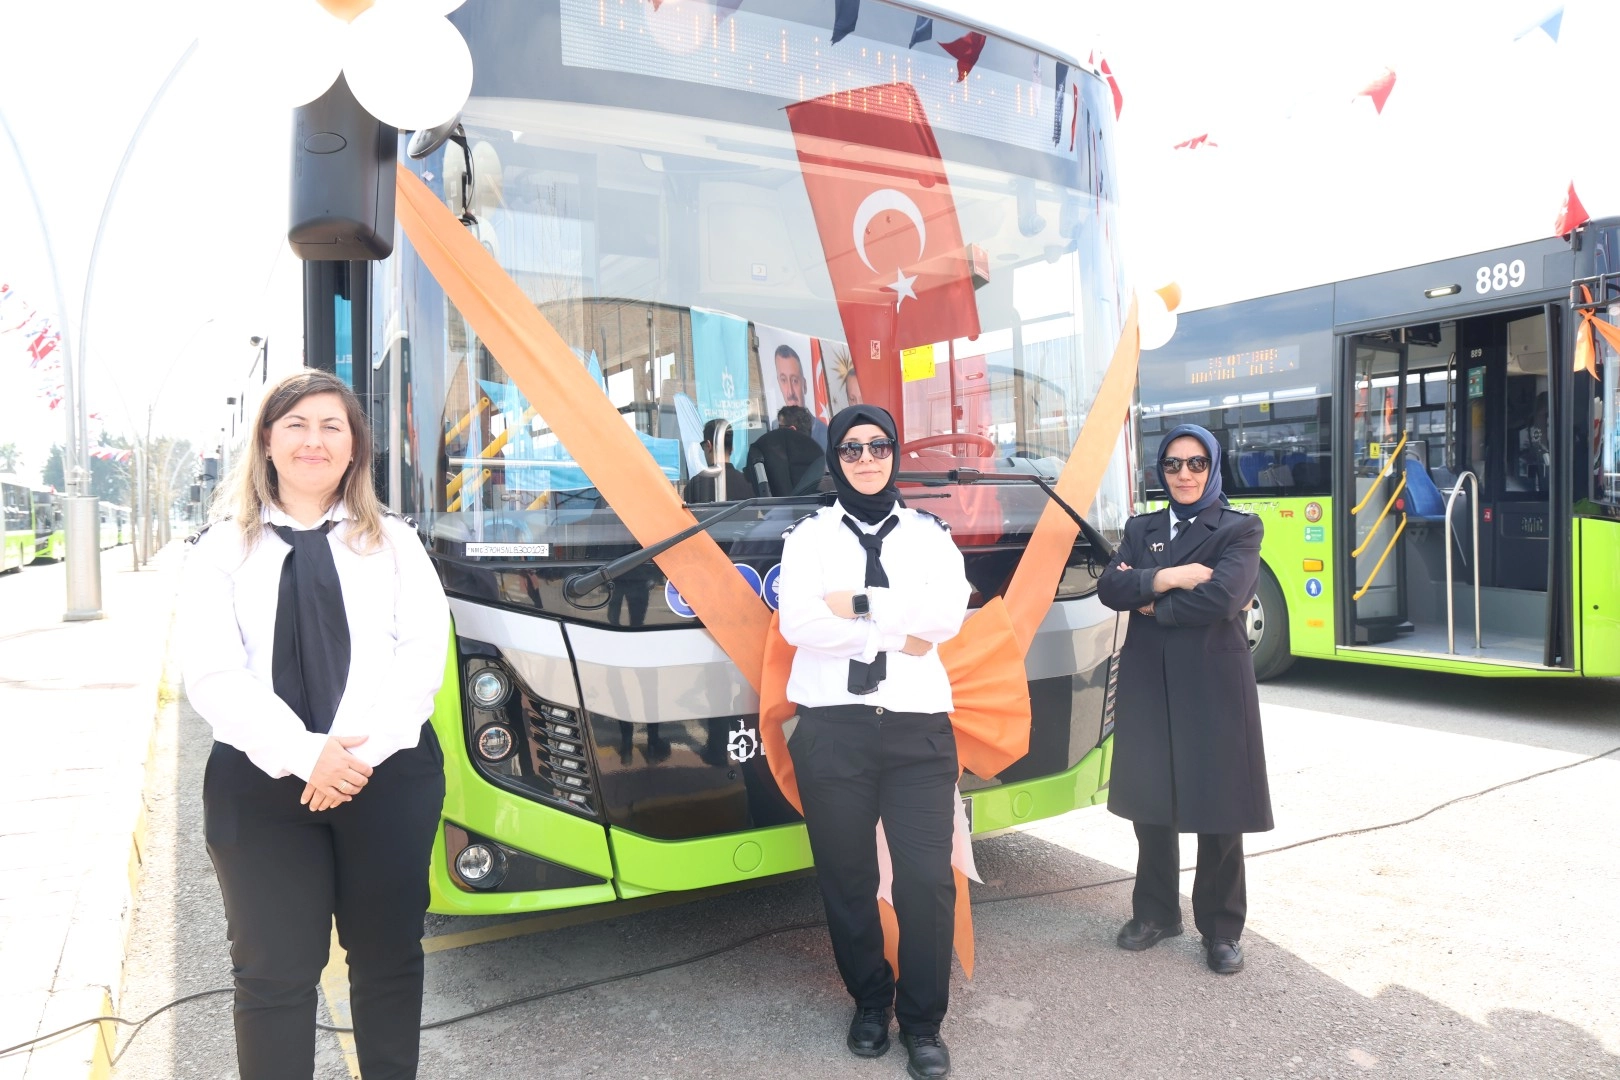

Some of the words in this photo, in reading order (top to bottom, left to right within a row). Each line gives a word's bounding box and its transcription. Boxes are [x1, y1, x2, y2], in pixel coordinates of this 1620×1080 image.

[1475, 259, 1526, 294] 889
[1470, 348, 1483, 358] 889
[1279, 510, 1294, 518] TR
